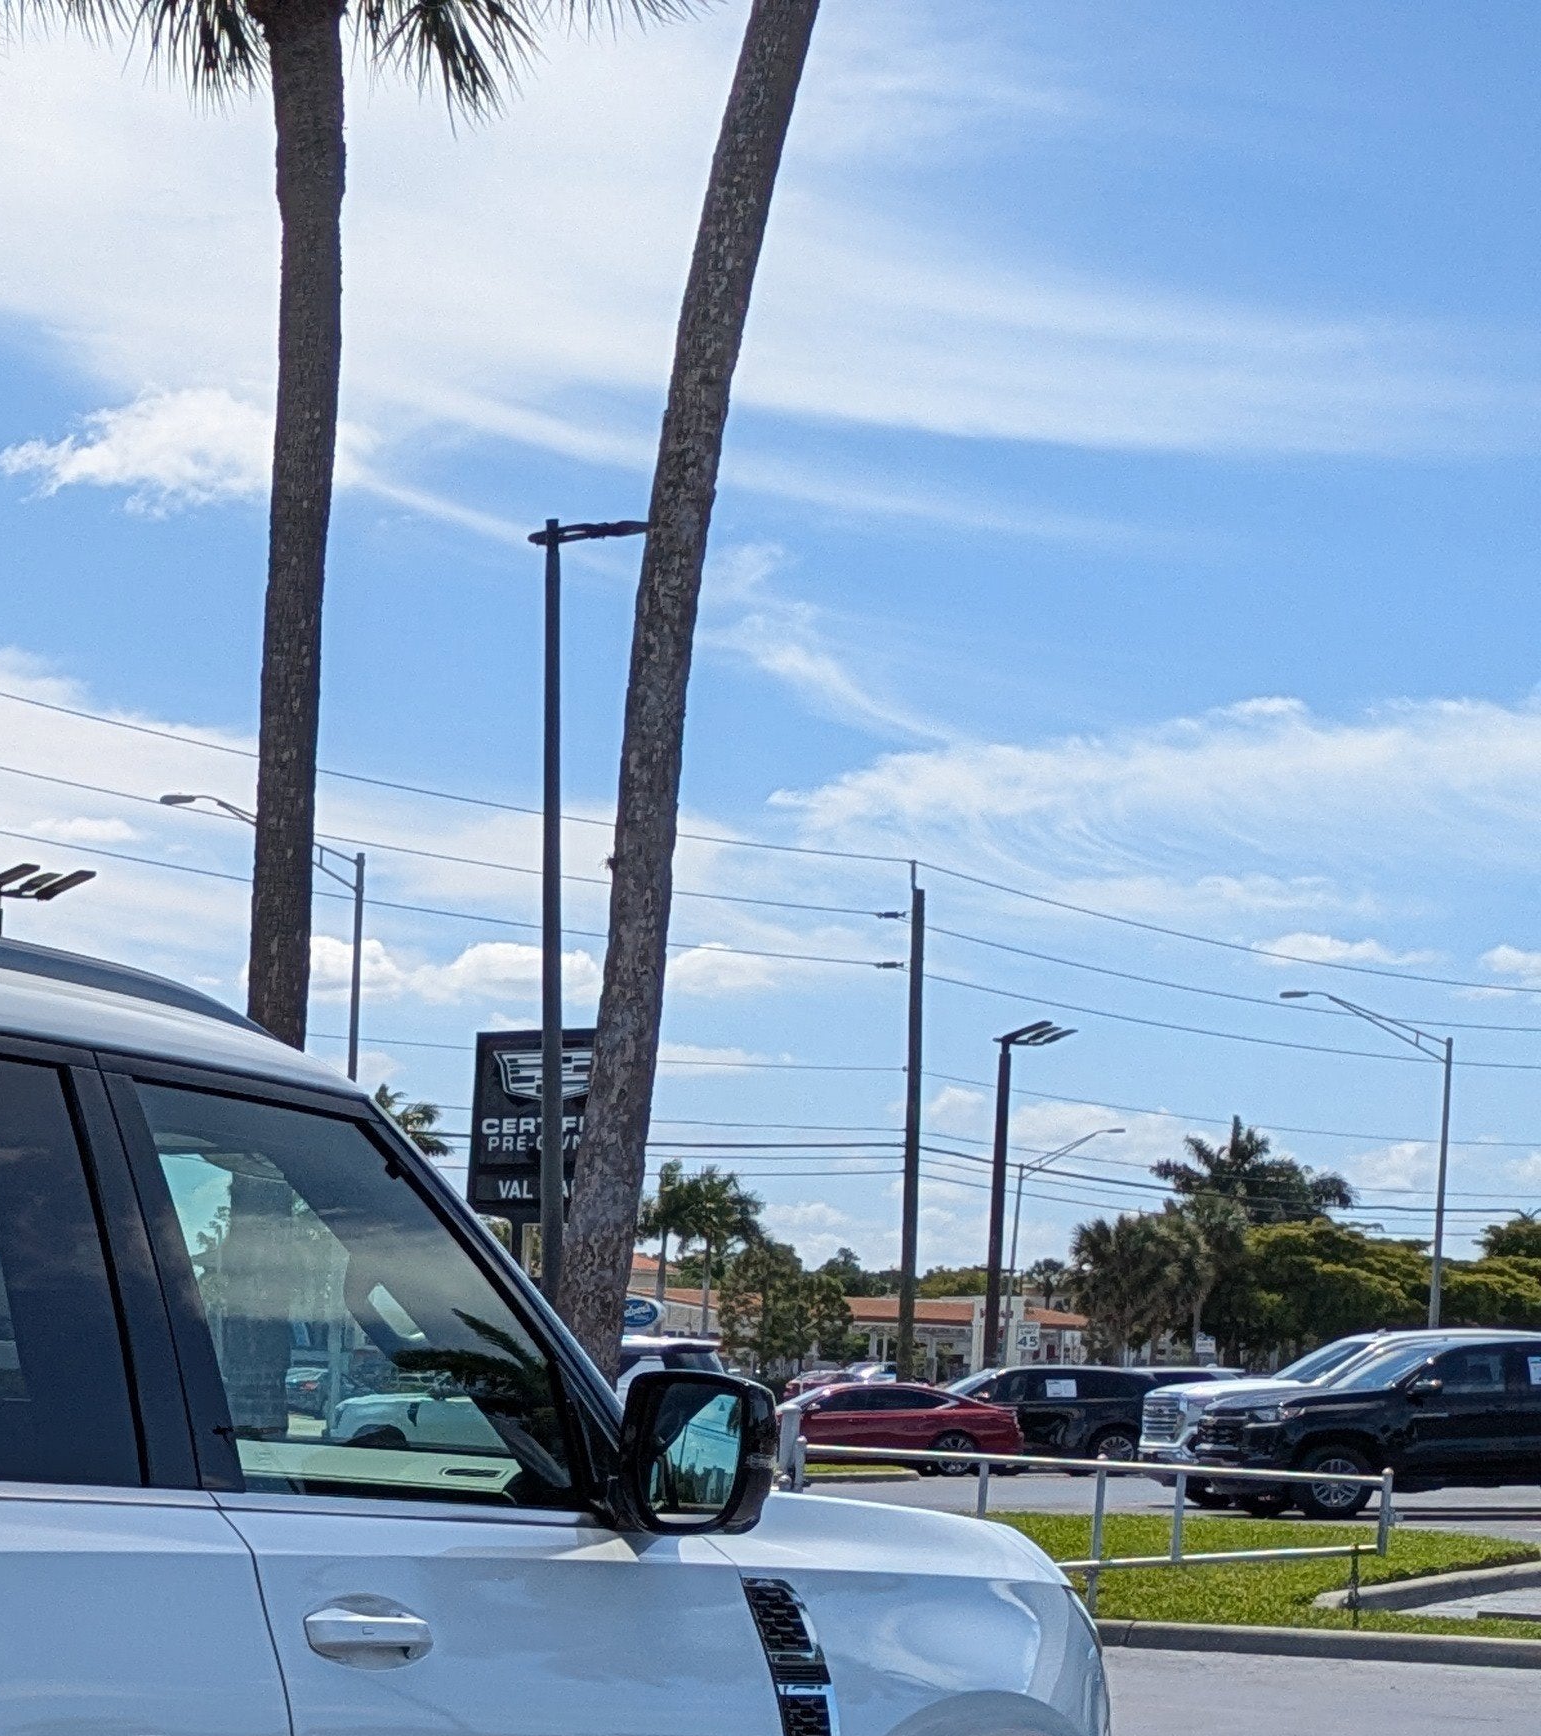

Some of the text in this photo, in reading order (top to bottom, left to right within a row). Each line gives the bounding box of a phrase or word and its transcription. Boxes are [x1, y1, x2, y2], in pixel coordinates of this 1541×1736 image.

[481, 1115, 585, 1135] CERFI
[498, 1179, 533, 1199] VAL
[1017, 1335, 1038, 1348] 45
